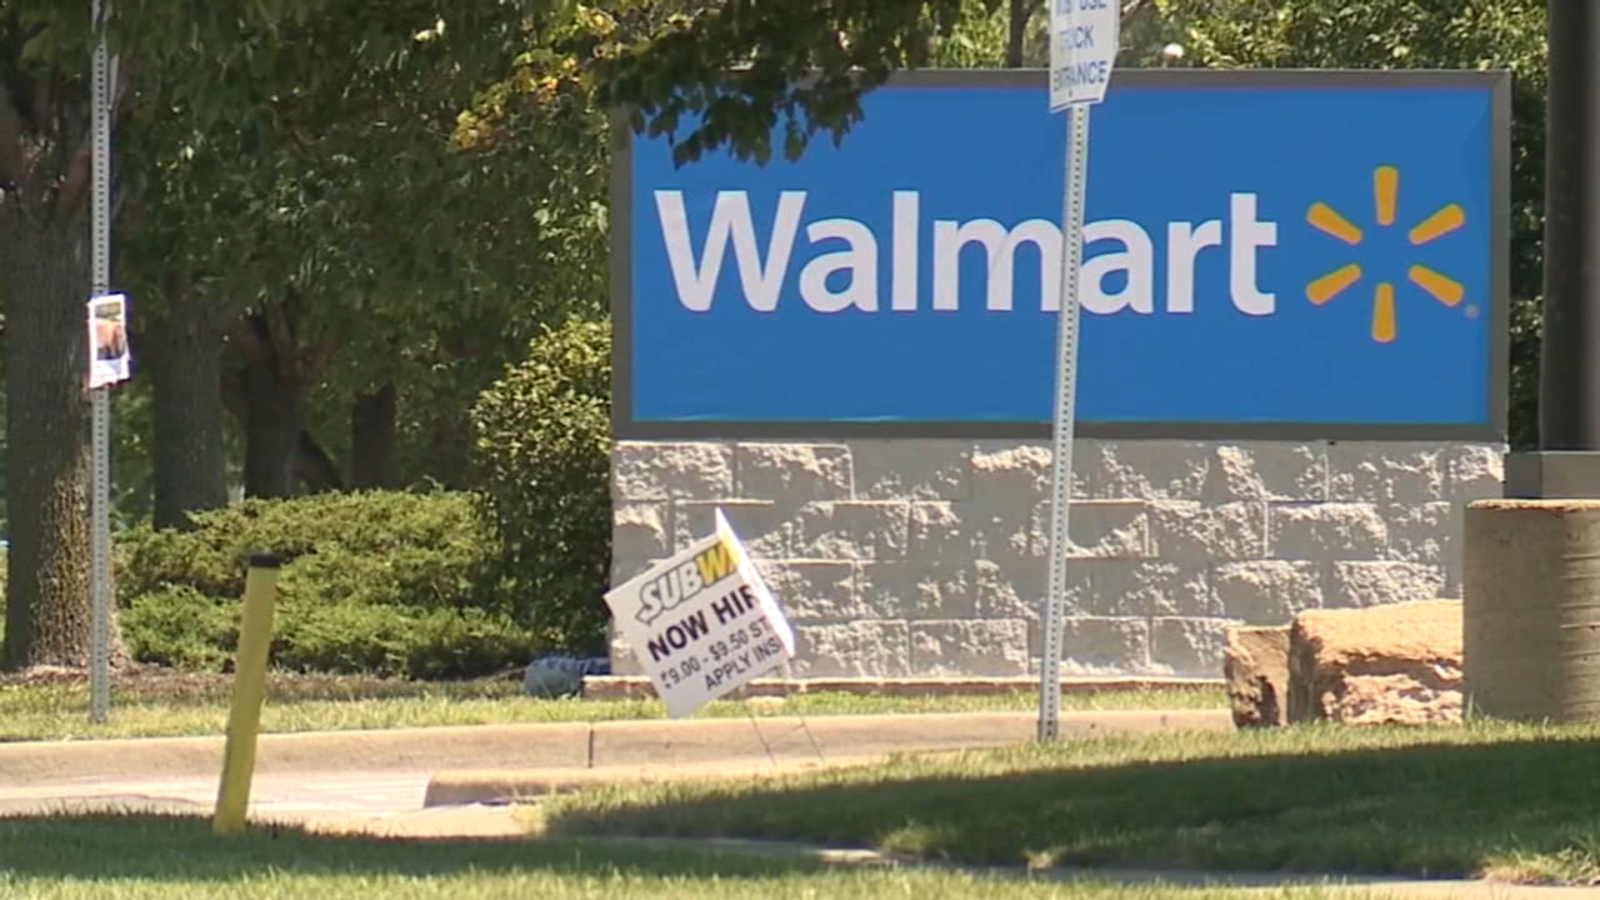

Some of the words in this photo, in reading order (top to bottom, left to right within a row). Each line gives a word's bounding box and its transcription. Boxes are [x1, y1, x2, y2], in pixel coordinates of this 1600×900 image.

[654, 189, 1277, 315] Walmart
[636, 542, 738, 625] SUBW
[647, 610, 709, 662] NOW
[708, 630, 748, 662] $9.50
[704, 652, 753, 691] APPLY
